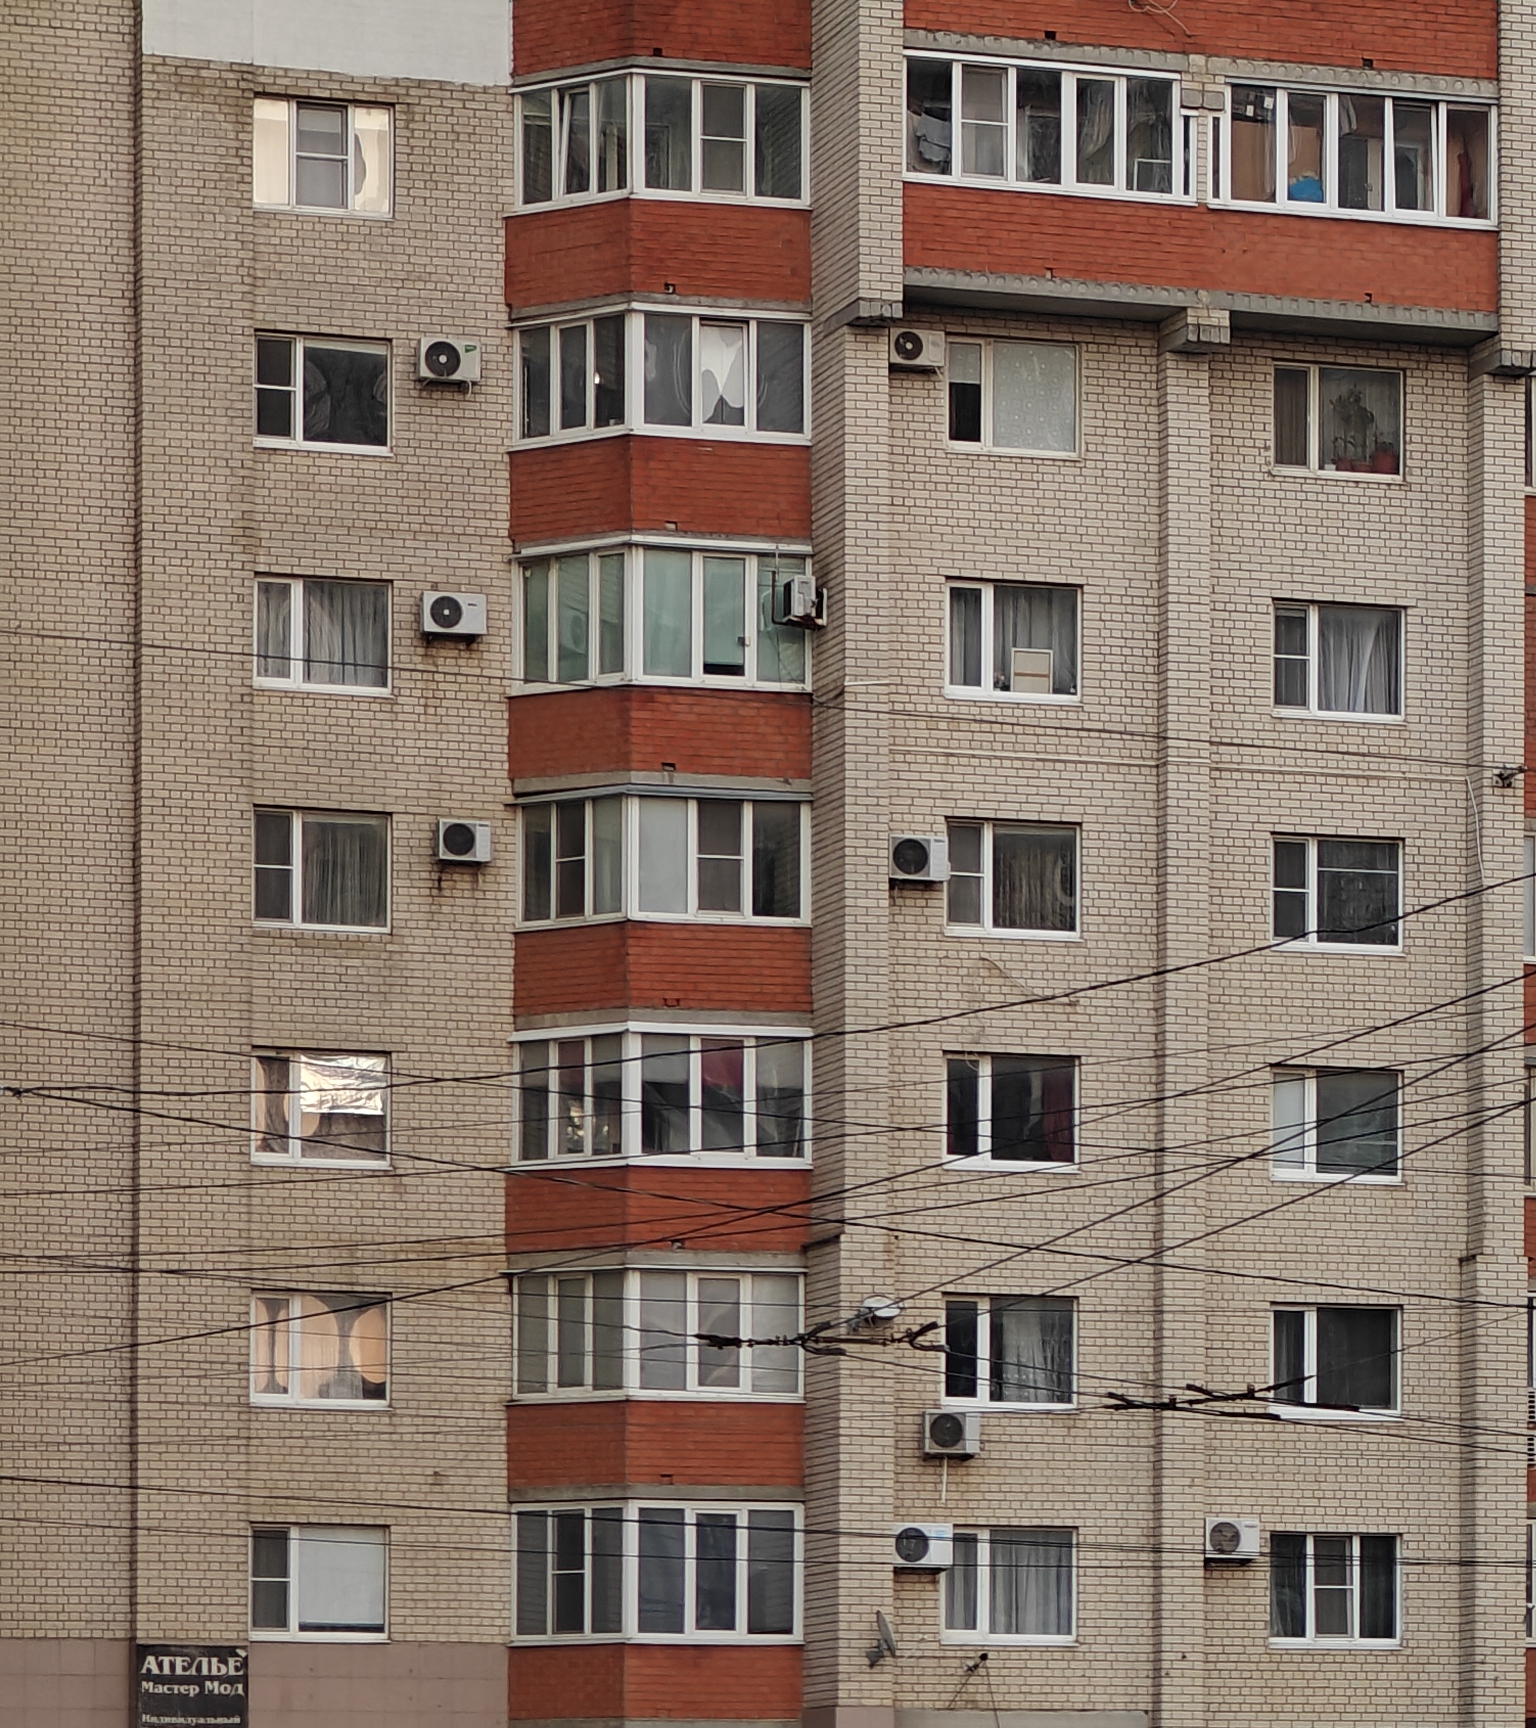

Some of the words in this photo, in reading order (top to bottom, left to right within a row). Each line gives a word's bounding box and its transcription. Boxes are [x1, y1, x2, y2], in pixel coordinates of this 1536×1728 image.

[140, 1655, 244, 1676] АТЕЛЬЕ
[141, 1680, 200, 1697] Мастер
[204, 1680, 245, 1697] Мод
